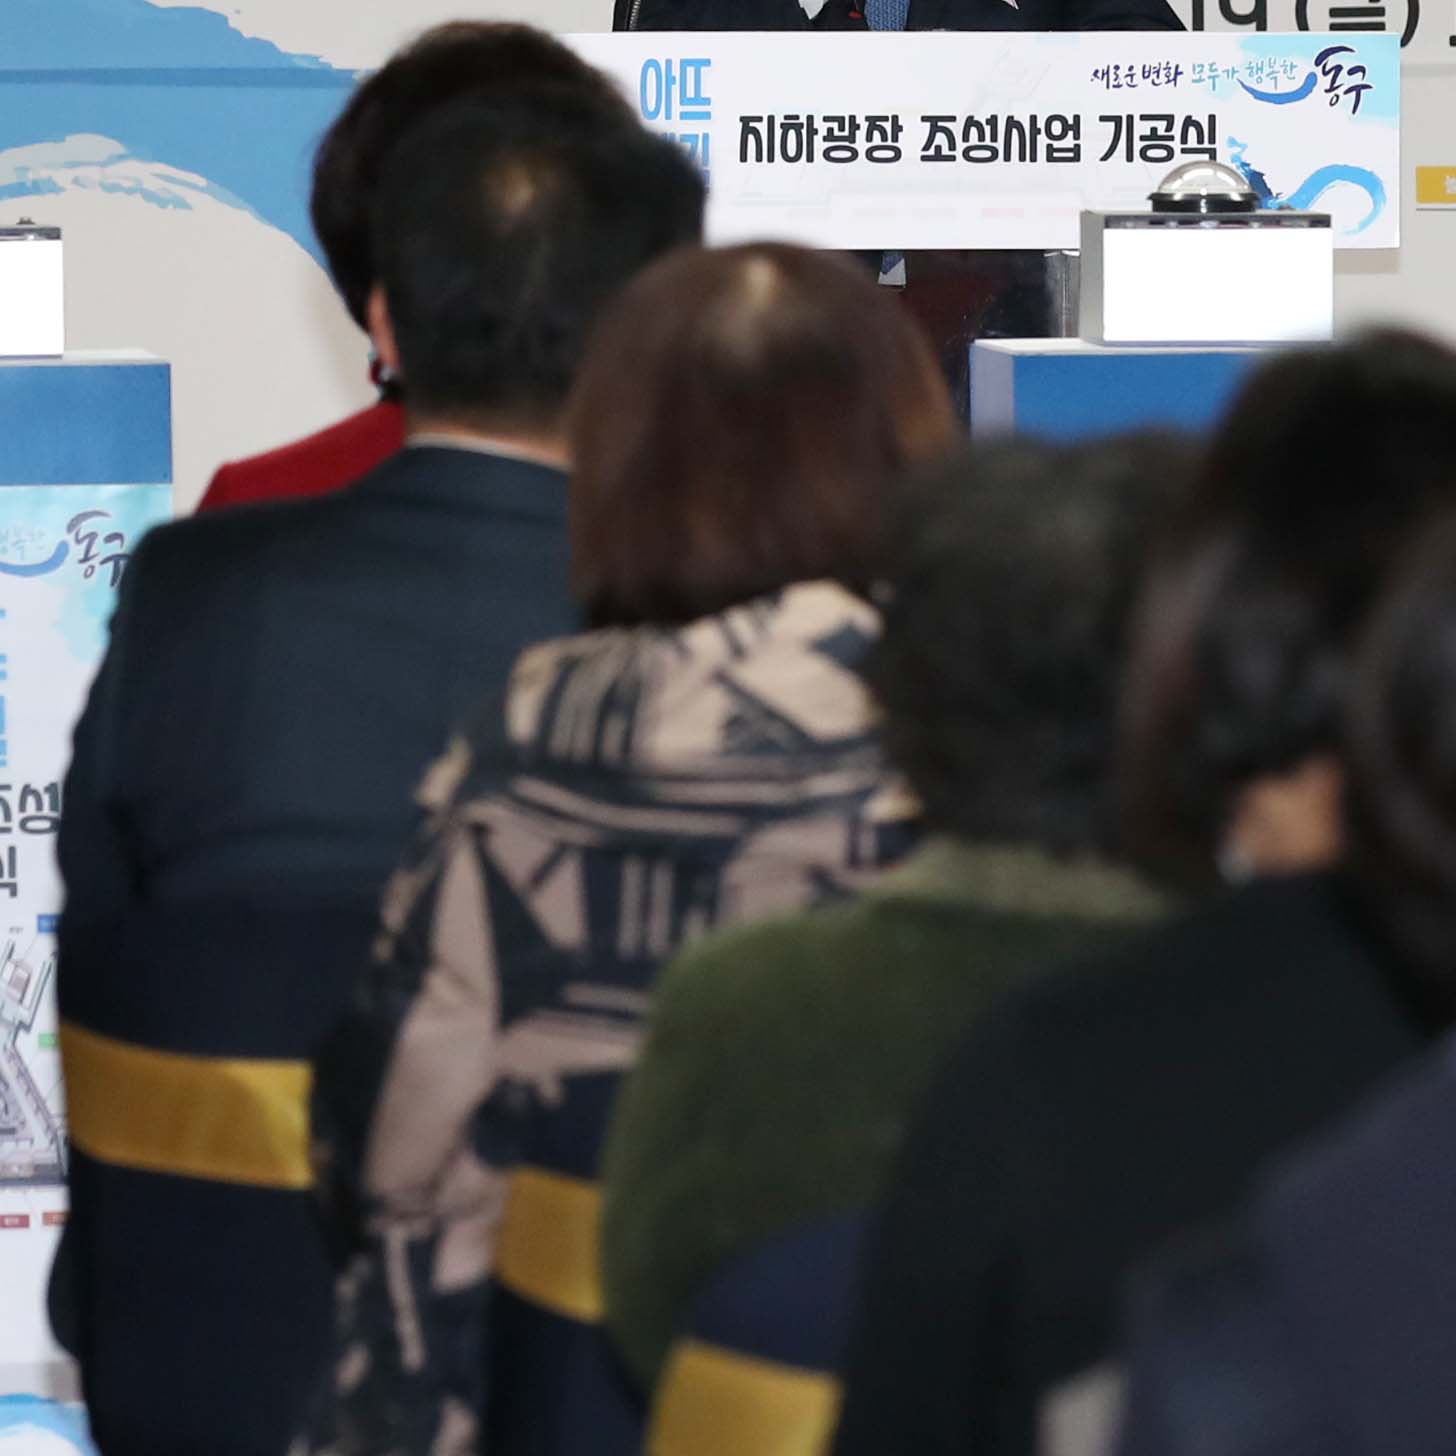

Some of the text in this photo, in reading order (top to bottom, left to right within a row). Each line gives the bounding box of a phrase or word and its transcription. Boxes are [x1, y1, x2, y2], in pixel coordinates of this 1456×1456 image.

[640, 57, 712, 121] 아뜨
[1090, 44, 1374, 116] 새로운 변화 모두가 행복한 동구
[739, 114, 904, 164] 지하광장
[920, 114, 1082, 164] 조성사업
[1098, 113, 1218, 163] 기공식
[66, 509, 131, 587] 동구
